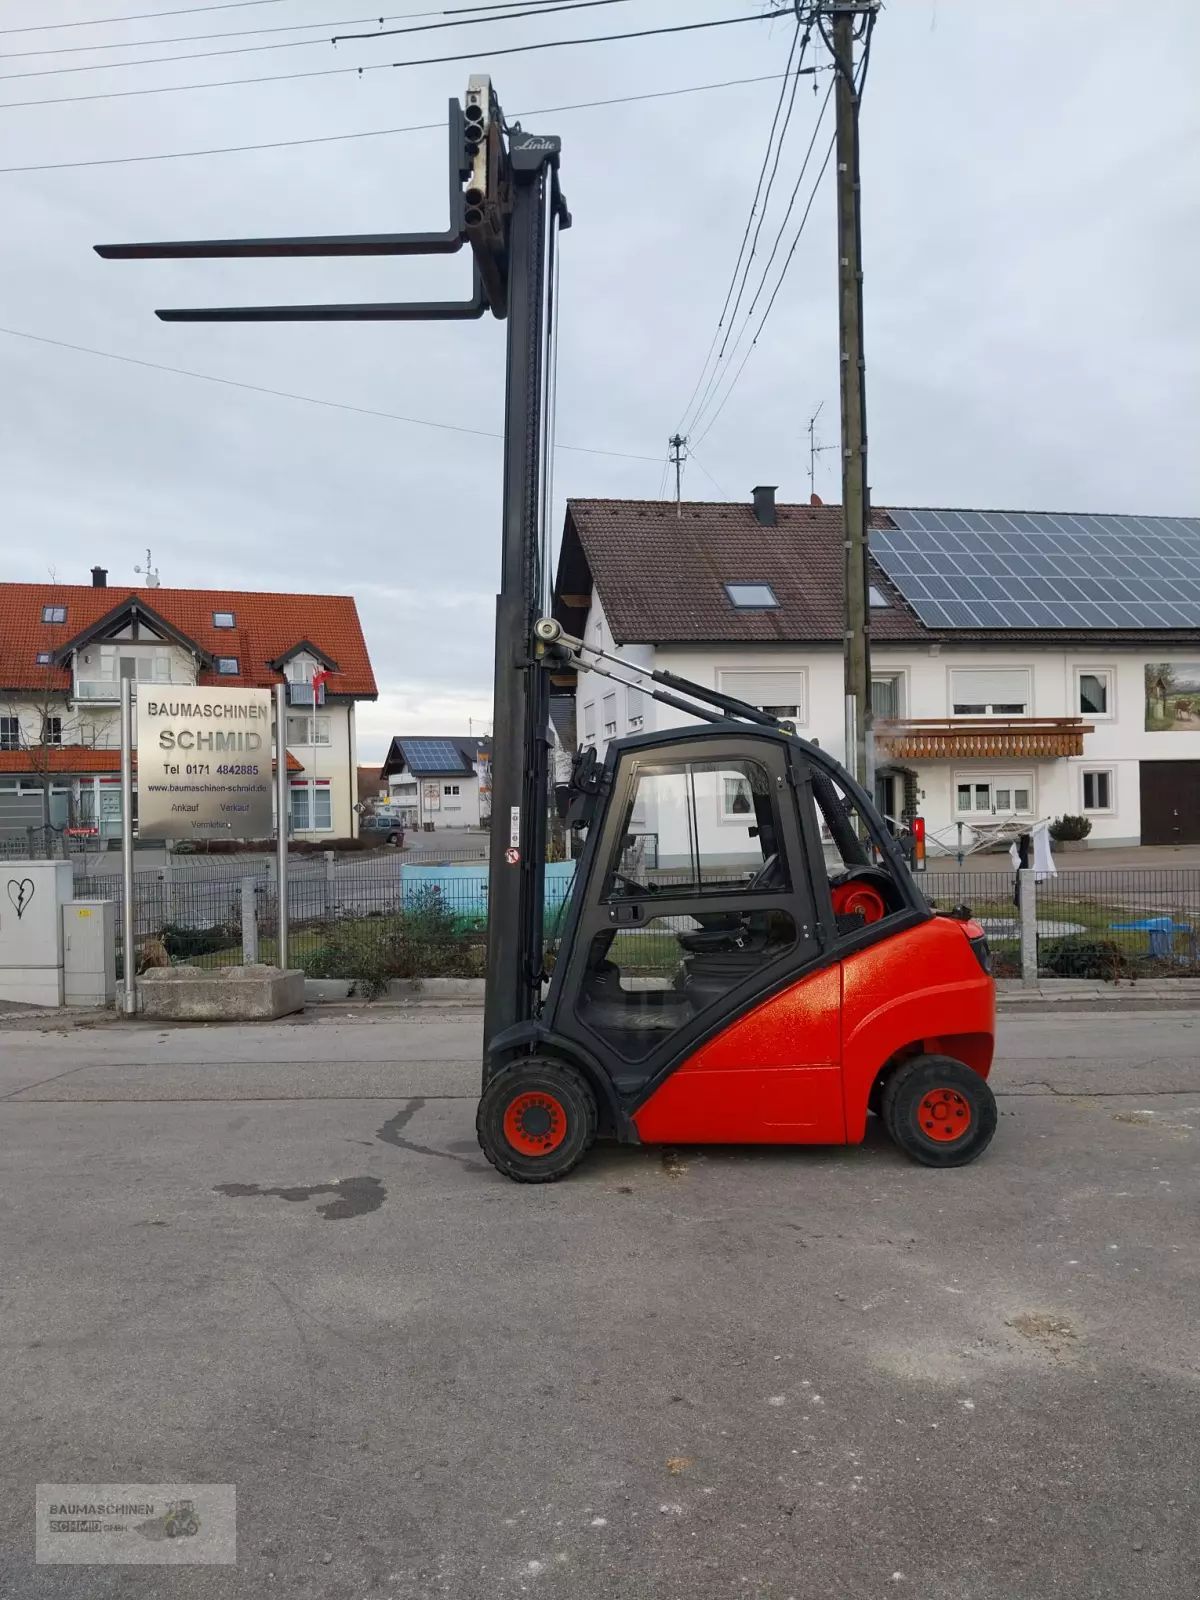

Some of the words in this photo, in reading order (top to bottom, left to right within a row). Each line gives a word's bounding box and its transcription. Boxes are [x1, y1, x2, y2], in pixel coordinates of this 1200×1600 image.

[514, 137, 555, 150] Linde
[148, 702, 267, 718] BAUMASCHINEN
[159, 730, 262, 752] SCHMID
[163, 764, 180, 775] Tel
[186, 765, 210, 775] 0171
[216, 765, 259, 775] 4842885
[148, 784, 267, 792] www.baumaschinen-schmid.de
[171, 803, 199, 812] Ankauf
[220, 804, 250, 812] Verkauf
